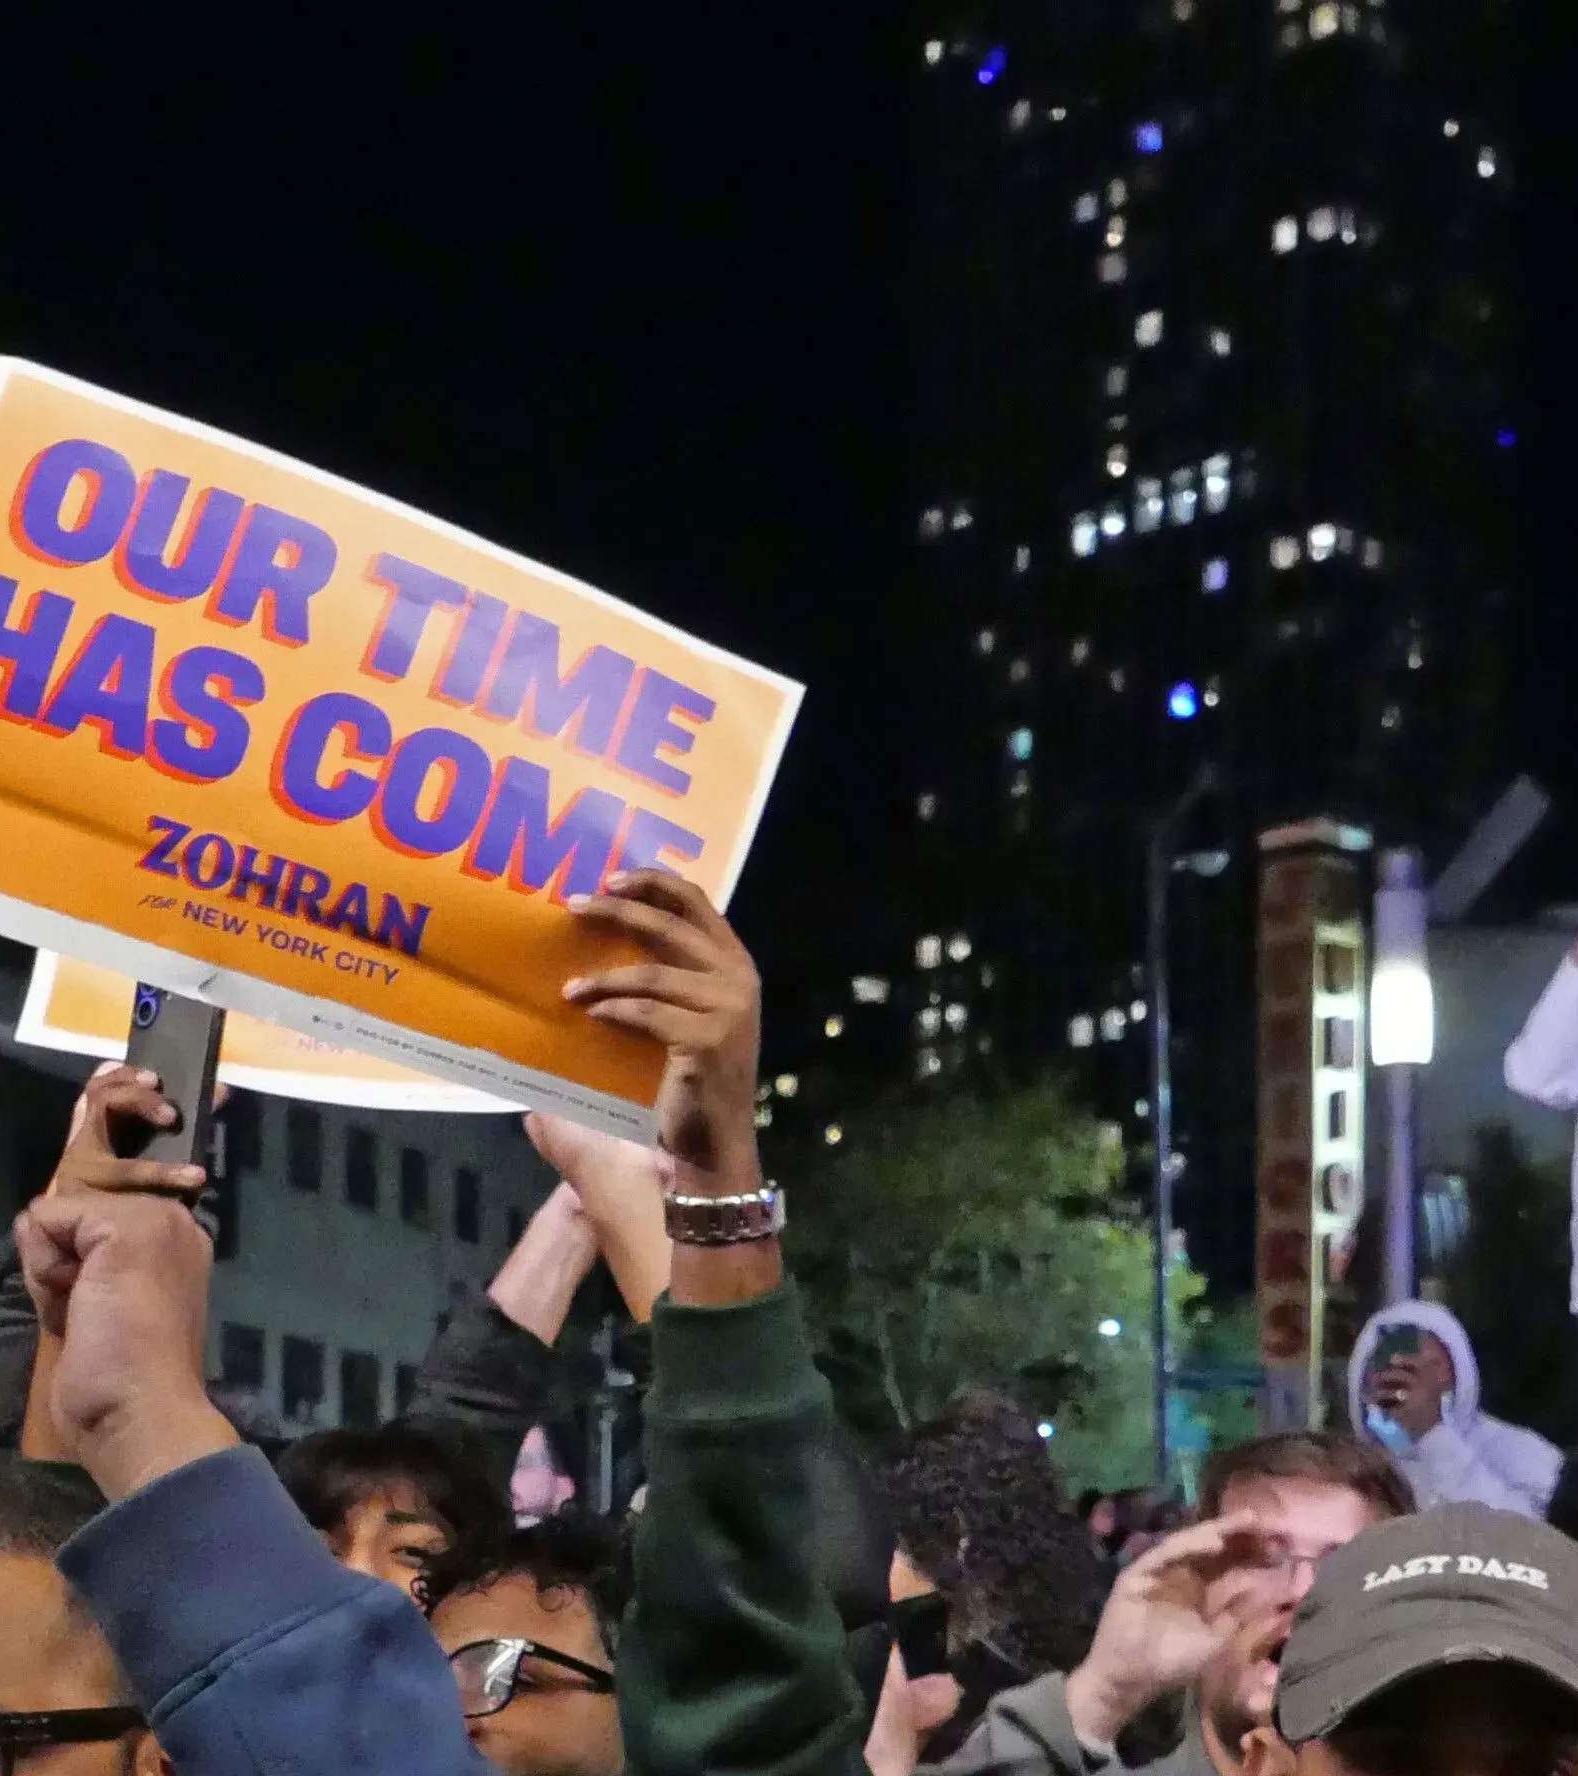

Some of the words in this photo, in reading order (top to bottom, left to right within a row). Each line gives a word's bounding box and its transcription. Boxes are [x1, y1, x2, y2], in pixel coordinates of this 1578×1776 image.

[8, 438, 339, 648] OUR
[360, 552, 717, 799] TIME
[135, 814, 433, 960] ZOHRAN
[182, 900, 249, 936] NEW
[257, 923, 331, 964] YORK
[334, 951, 401, 986] CITY
[1362, 1554, 1452, 1592] LAZY
[1455, 1555, 1551, 1591] DAZE
